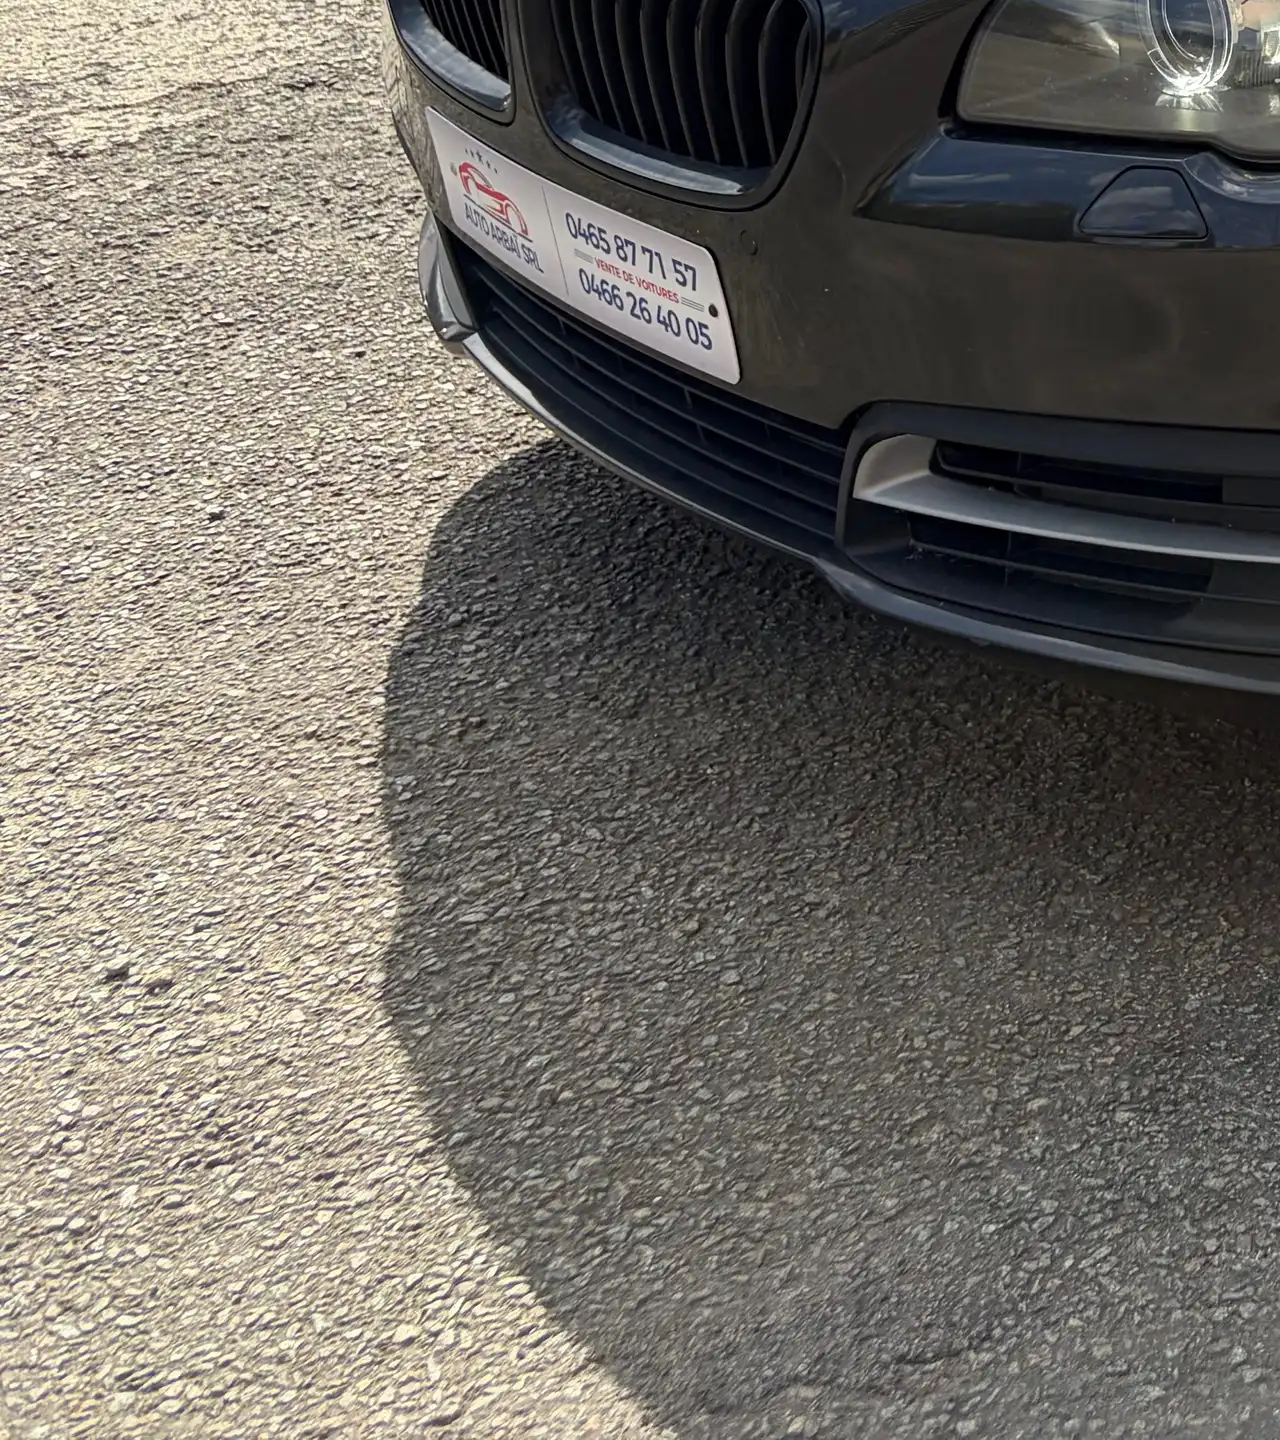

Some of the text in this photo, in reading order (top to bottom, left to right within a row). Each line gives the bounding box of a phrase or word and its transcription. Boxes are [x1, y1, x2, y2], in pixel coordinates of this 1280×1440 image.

[465, 203, 489, 236] AUTO
[521, 242, 544, 274] SRL
[565, 212, 697, 291] 0465 87 71 57
[579, 268, 713, 351] 0466 26 40 05
[595, 257, 679, 304] VENTE DE VOITURES
